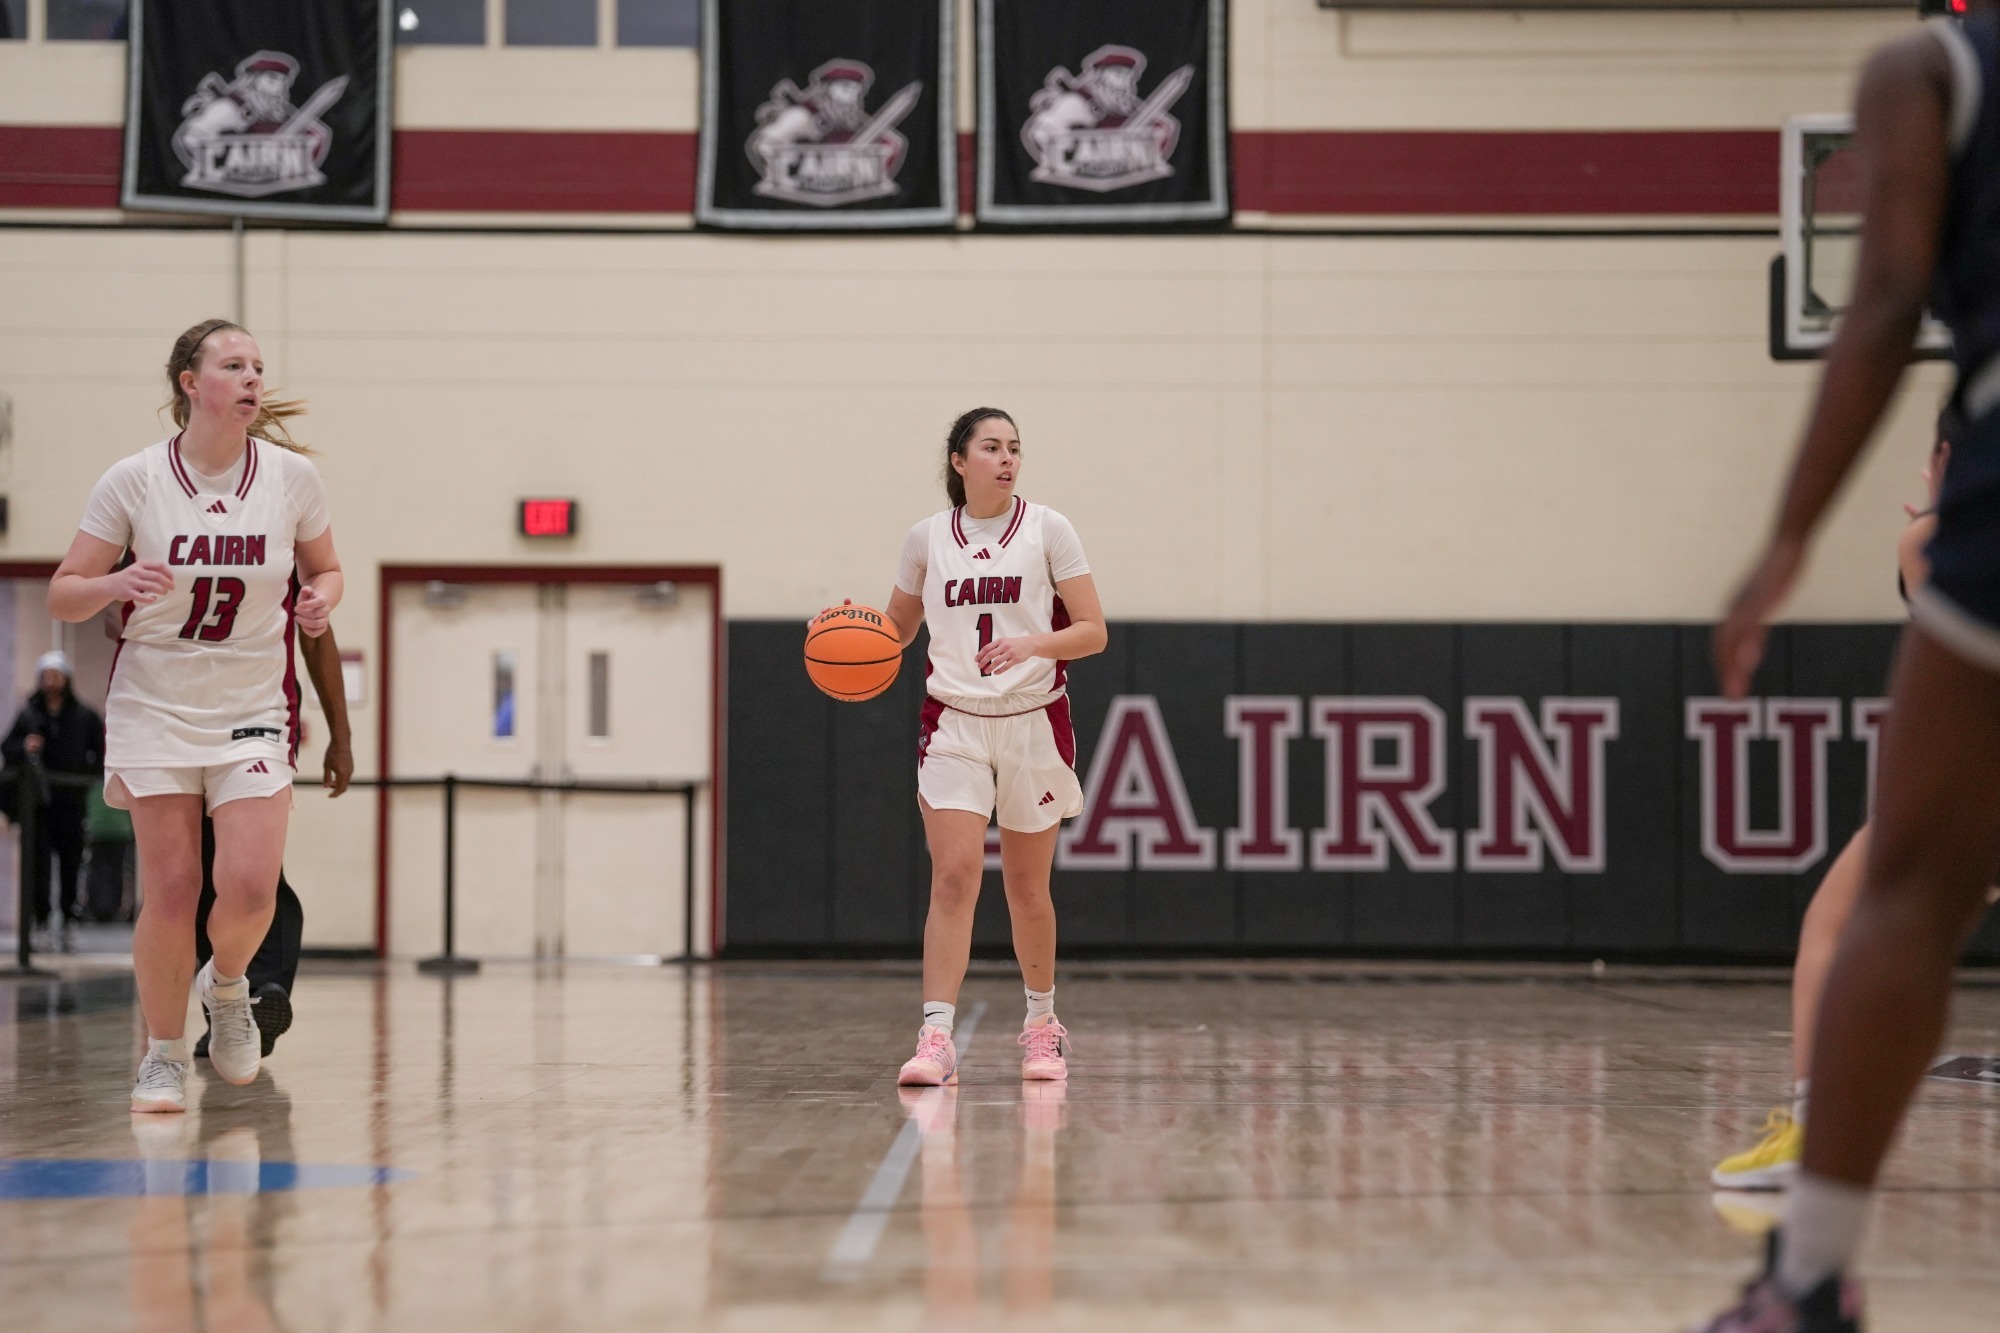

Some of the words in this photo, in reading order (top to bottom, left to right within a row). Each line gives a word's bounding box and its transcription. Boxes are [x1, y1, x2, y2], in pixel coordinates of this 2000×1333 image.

[168, 534, 266, 566] CAIRN
[178, 577, 246, 642] 13
[945, 576, 1022, 607] CAIRN
[820, 609, 883, 628] Wilson
[976, 613, 993, 677] 1
[926, 694, 1619, 873] AIRN
[1684, 697, 1890, 874] U
